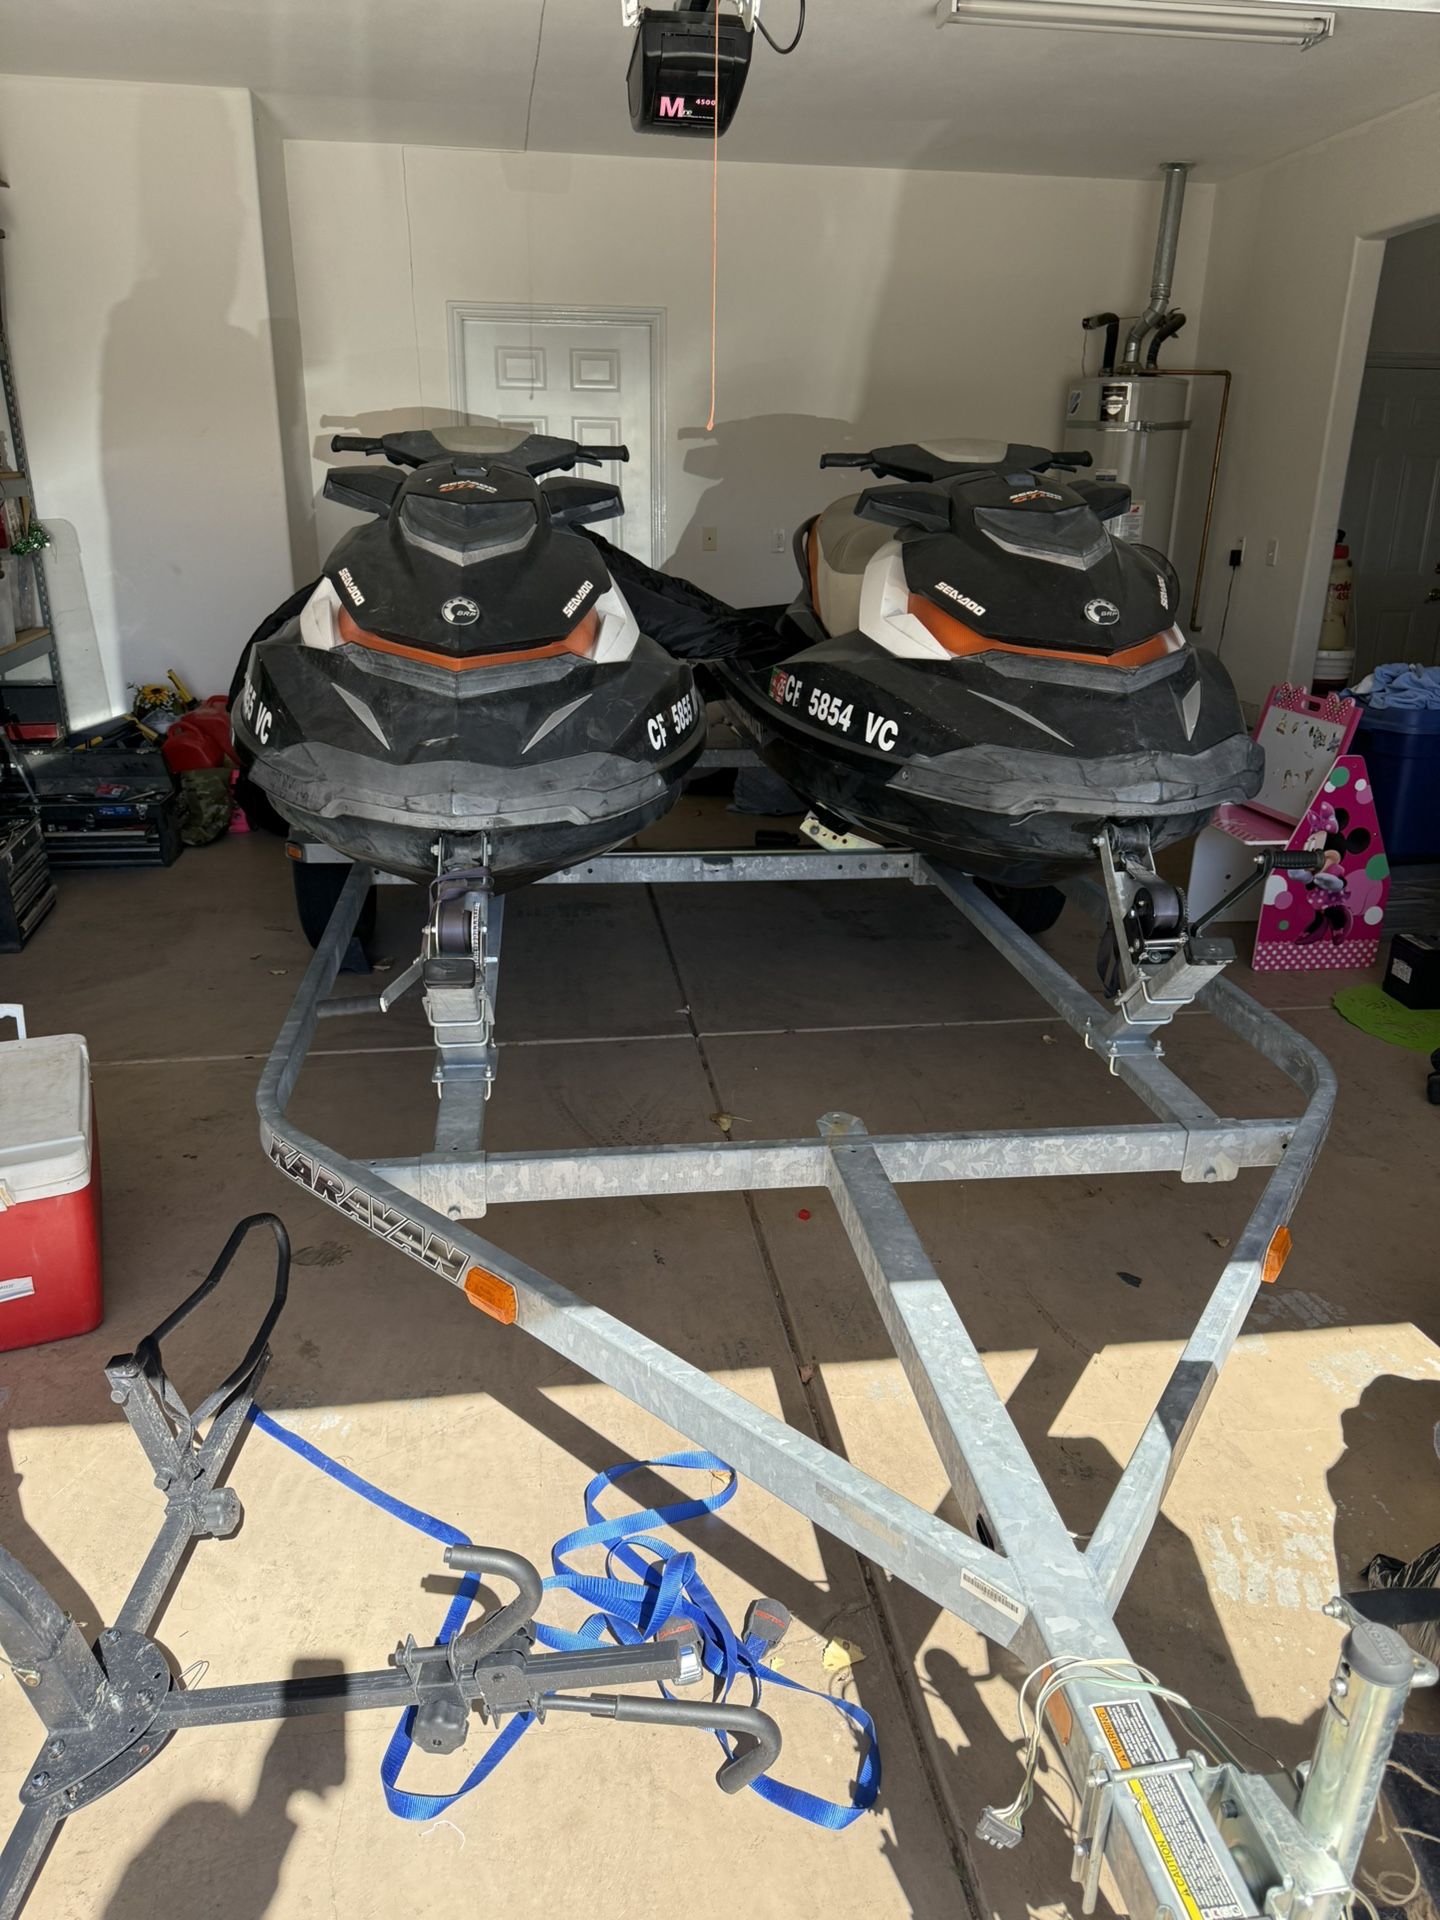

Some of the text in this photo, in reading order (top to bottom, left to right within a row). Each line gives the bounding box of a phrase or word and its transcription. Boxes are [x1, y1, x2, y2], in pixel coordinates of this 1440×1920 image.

[255, 701, 272, 745] VC
[647, 713, 667, 751] CF
[671, 694, 693, 735] 5855
[808, 688, 854, 732] 5854
[865, 712, 899, 752] VC
[269, 1133, 471, 1283] KARAVAN
[1099, 1712, 1123, 1753] WARNING
[1157, 1840, 1185, 1887] CAUTION
